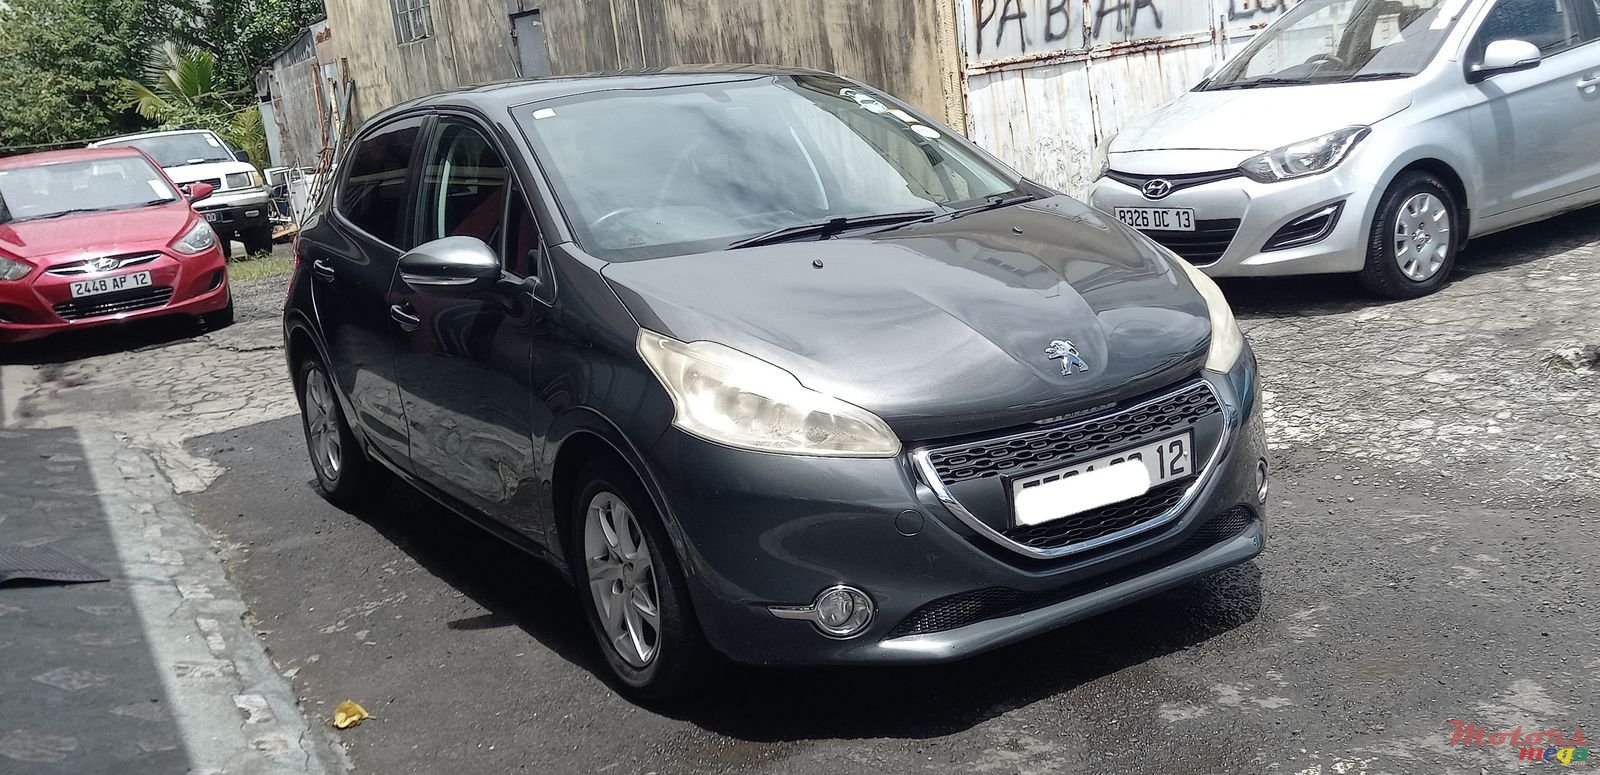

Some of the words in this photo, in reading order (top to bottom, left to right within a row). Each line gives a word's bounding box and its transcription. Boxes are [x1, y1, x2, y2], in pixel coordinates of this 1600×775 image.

[1119, 209, 1149, 227] 8326
[1154, 210, 1170, 227] DC
[1175, 211, 1191, 228] 13
[75, 280, 107, 296] 2448
[112, 277, 127, 292] AP
[133, 273, 148, 286] 12
[1156, 439, 1185, 480] 12
